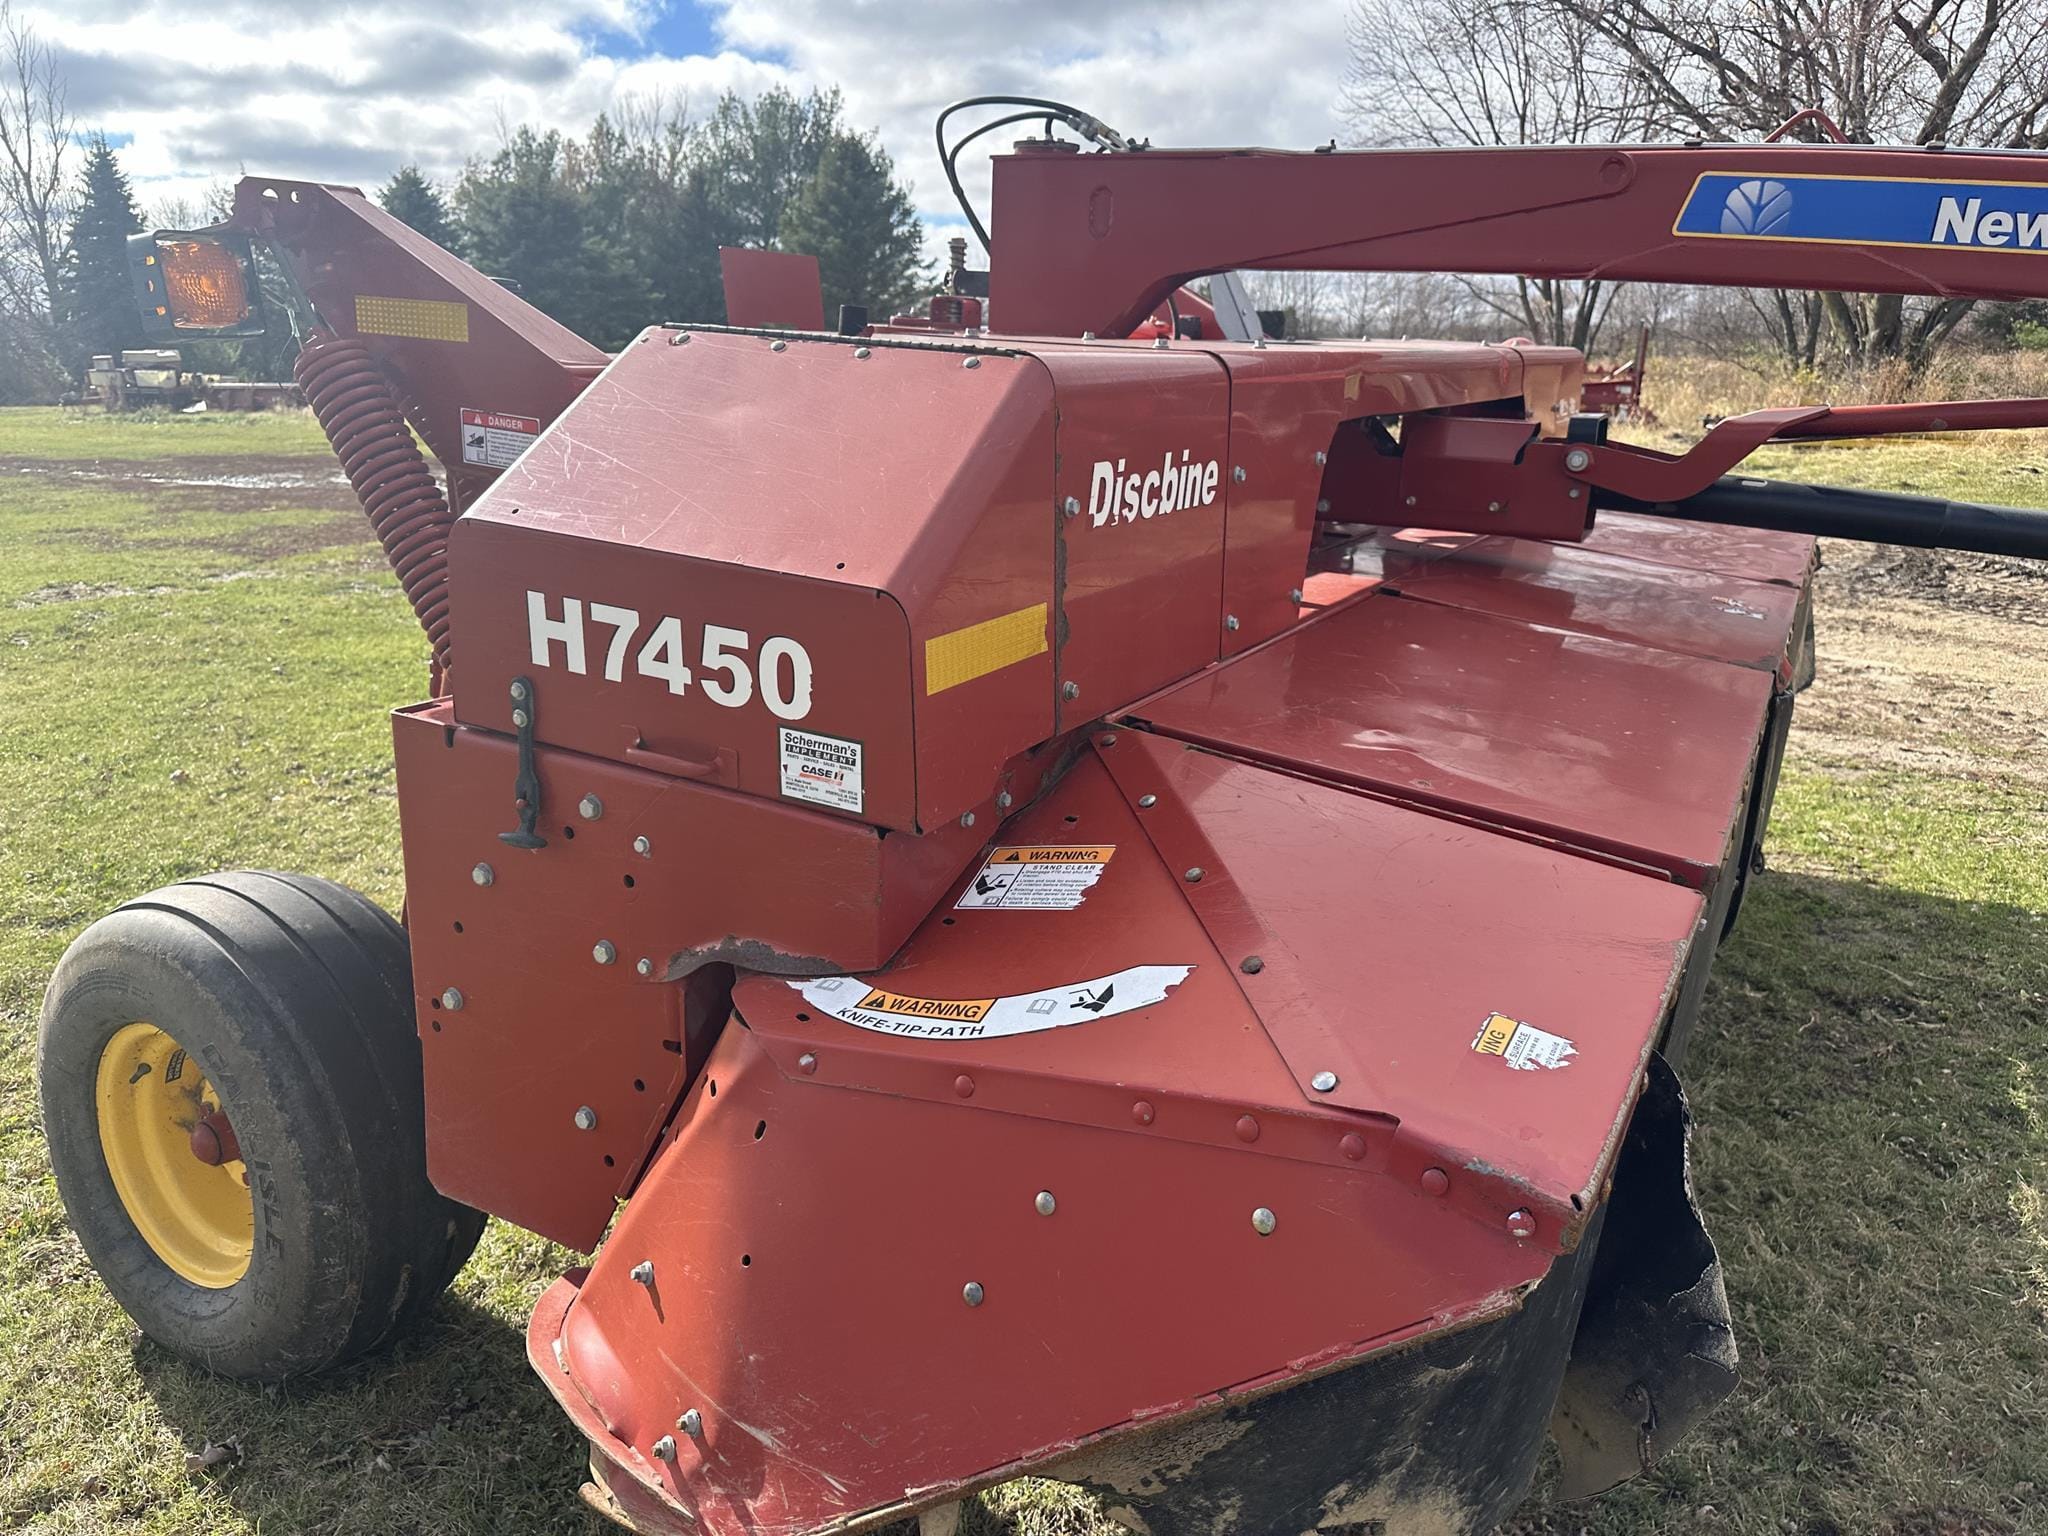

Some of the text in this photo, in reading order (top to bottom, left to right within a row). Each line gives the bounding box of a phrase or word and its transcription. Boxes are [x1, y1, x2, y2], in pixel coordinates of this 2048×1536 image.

[488, 416, 523, 431] DANGER
[1089, 449, 1219, 529] Discbine
[526, 590, 813, 720] H7450
[784, 732, 857, 757] Scherrman's
[787, 745, 855, 765] IMPLEMENT
[801, 765, 832, 778] CASE
[1029, 850, 1100, 861] WARNING
[889, 998, 981, 1019] WARNING
[837, 1007, 985, 1037] KNIFE-TIP-PATH
[1509, 1031, 1529, 1059] SURFACE
